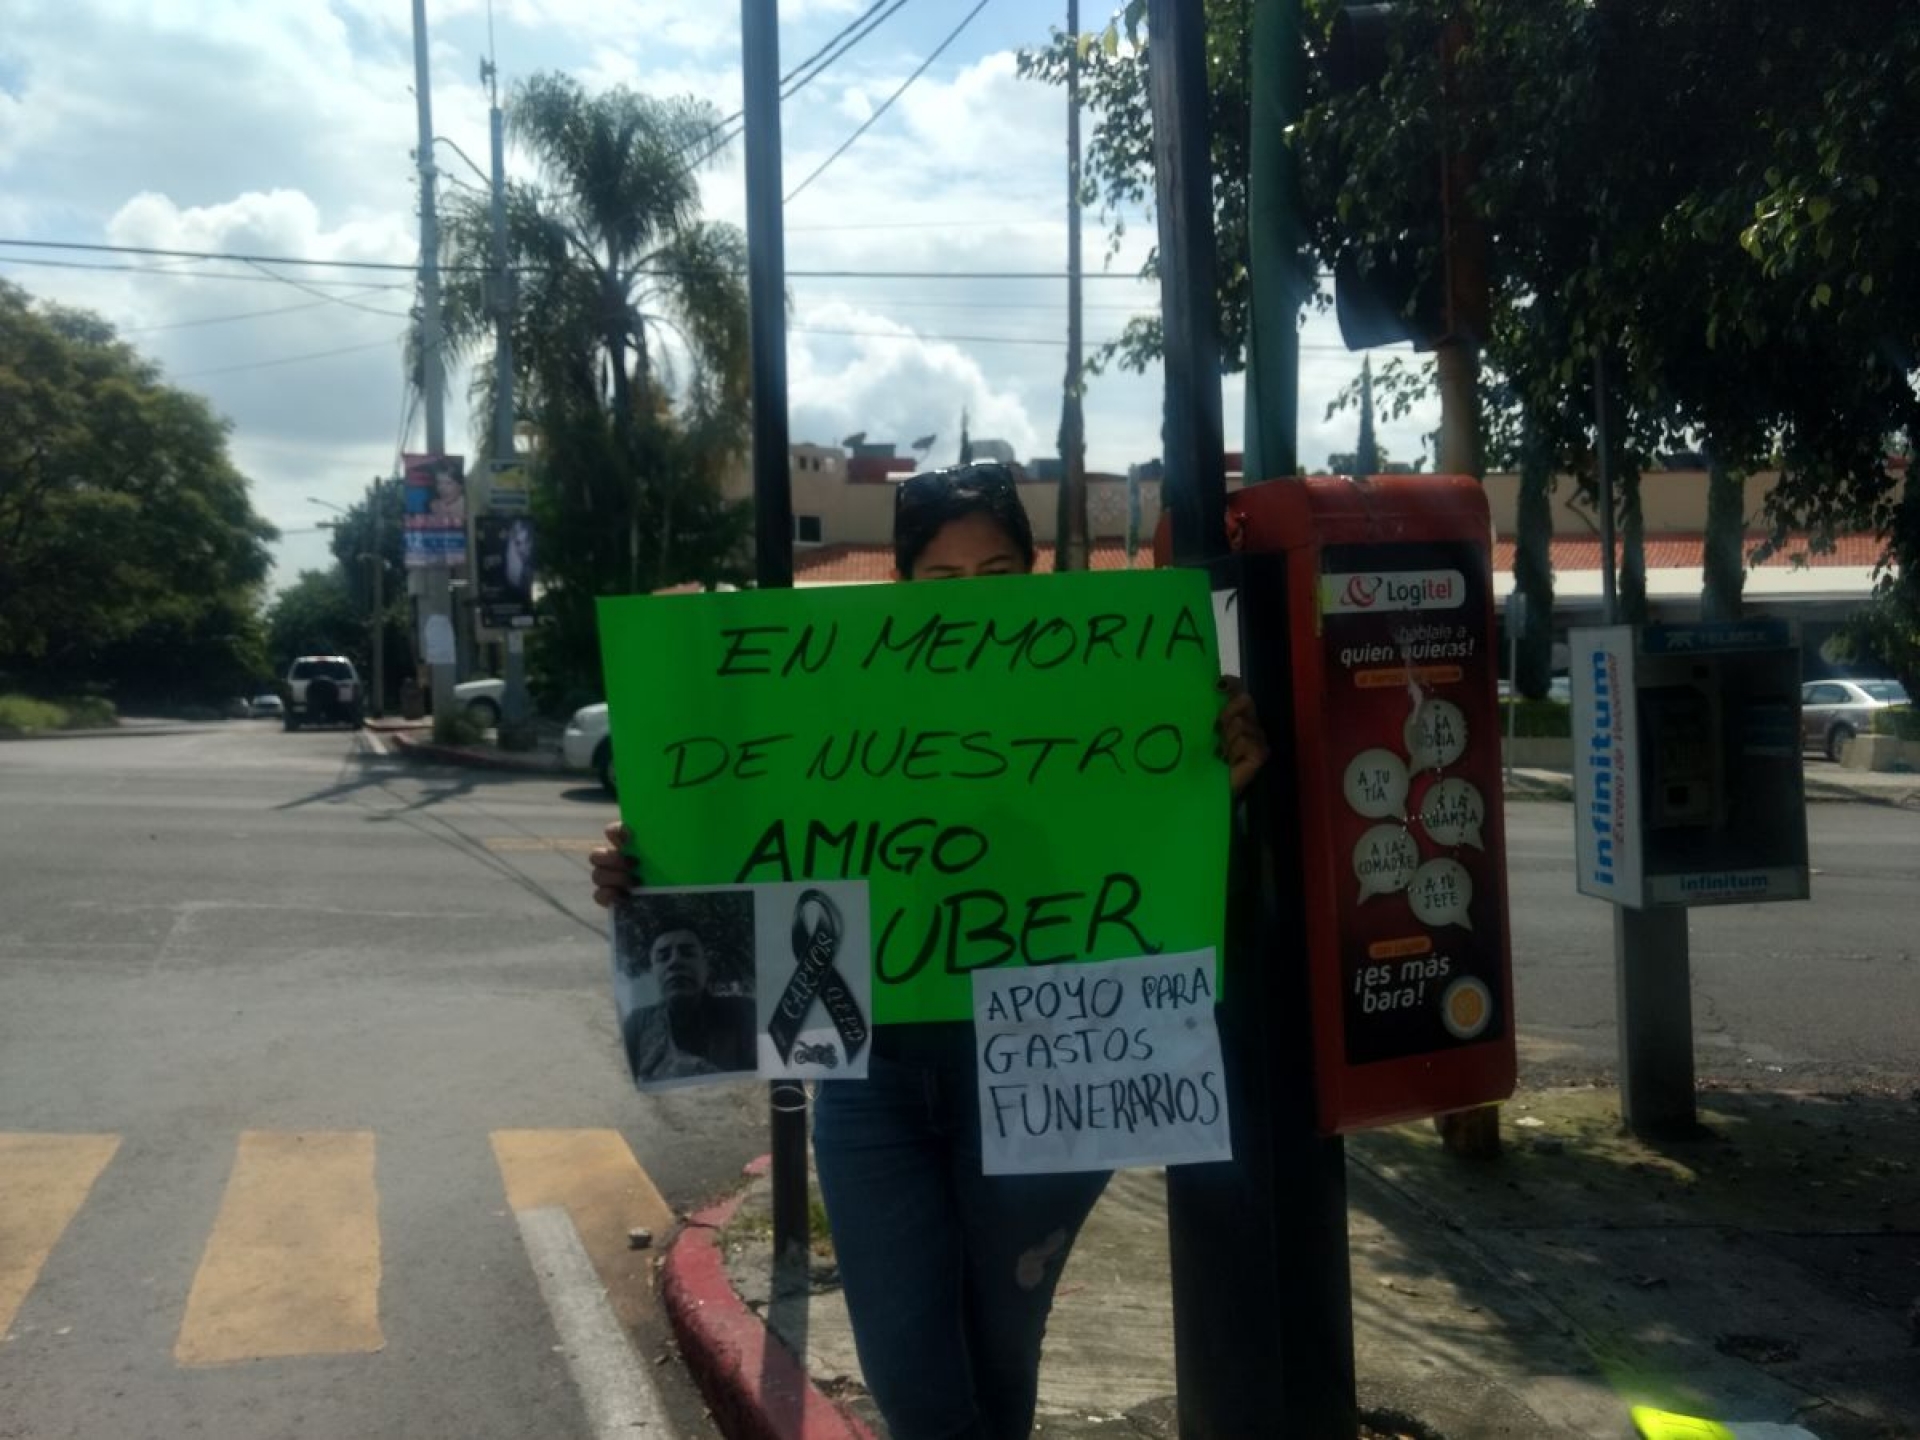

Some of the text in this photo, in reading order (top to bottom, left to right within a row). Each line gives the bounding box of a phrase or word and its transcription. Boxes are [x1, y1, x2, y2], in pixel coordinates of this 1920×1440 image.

[1387, 577, 1453, 607] Logitel
[716, 605, 1208, 677] EN MEMORIA
[1340, 642, 1394, 669] quien
[664, 723, 1184, 788] DE NUESTRO
[1357, 769, 1391, 786] A TU
[1590, 651, 1614, 886] infinitum
[734, 816, 989, 882] AMIGO
[1370, 842, 1380, 856] A
[1680, 871, 1769, 893] infinitum
[874, 872, 1164, 985] UBER
[987, 966, 1212, 1023] APOYO PARA
[1354, 951, 1451, 996] ¡es más
[1362, 980, 1427, 1014] bara!
[983, 1026, 1154, 1074] GASTOS
[988, 1070, 1220, 1138] FUNERARIOS
